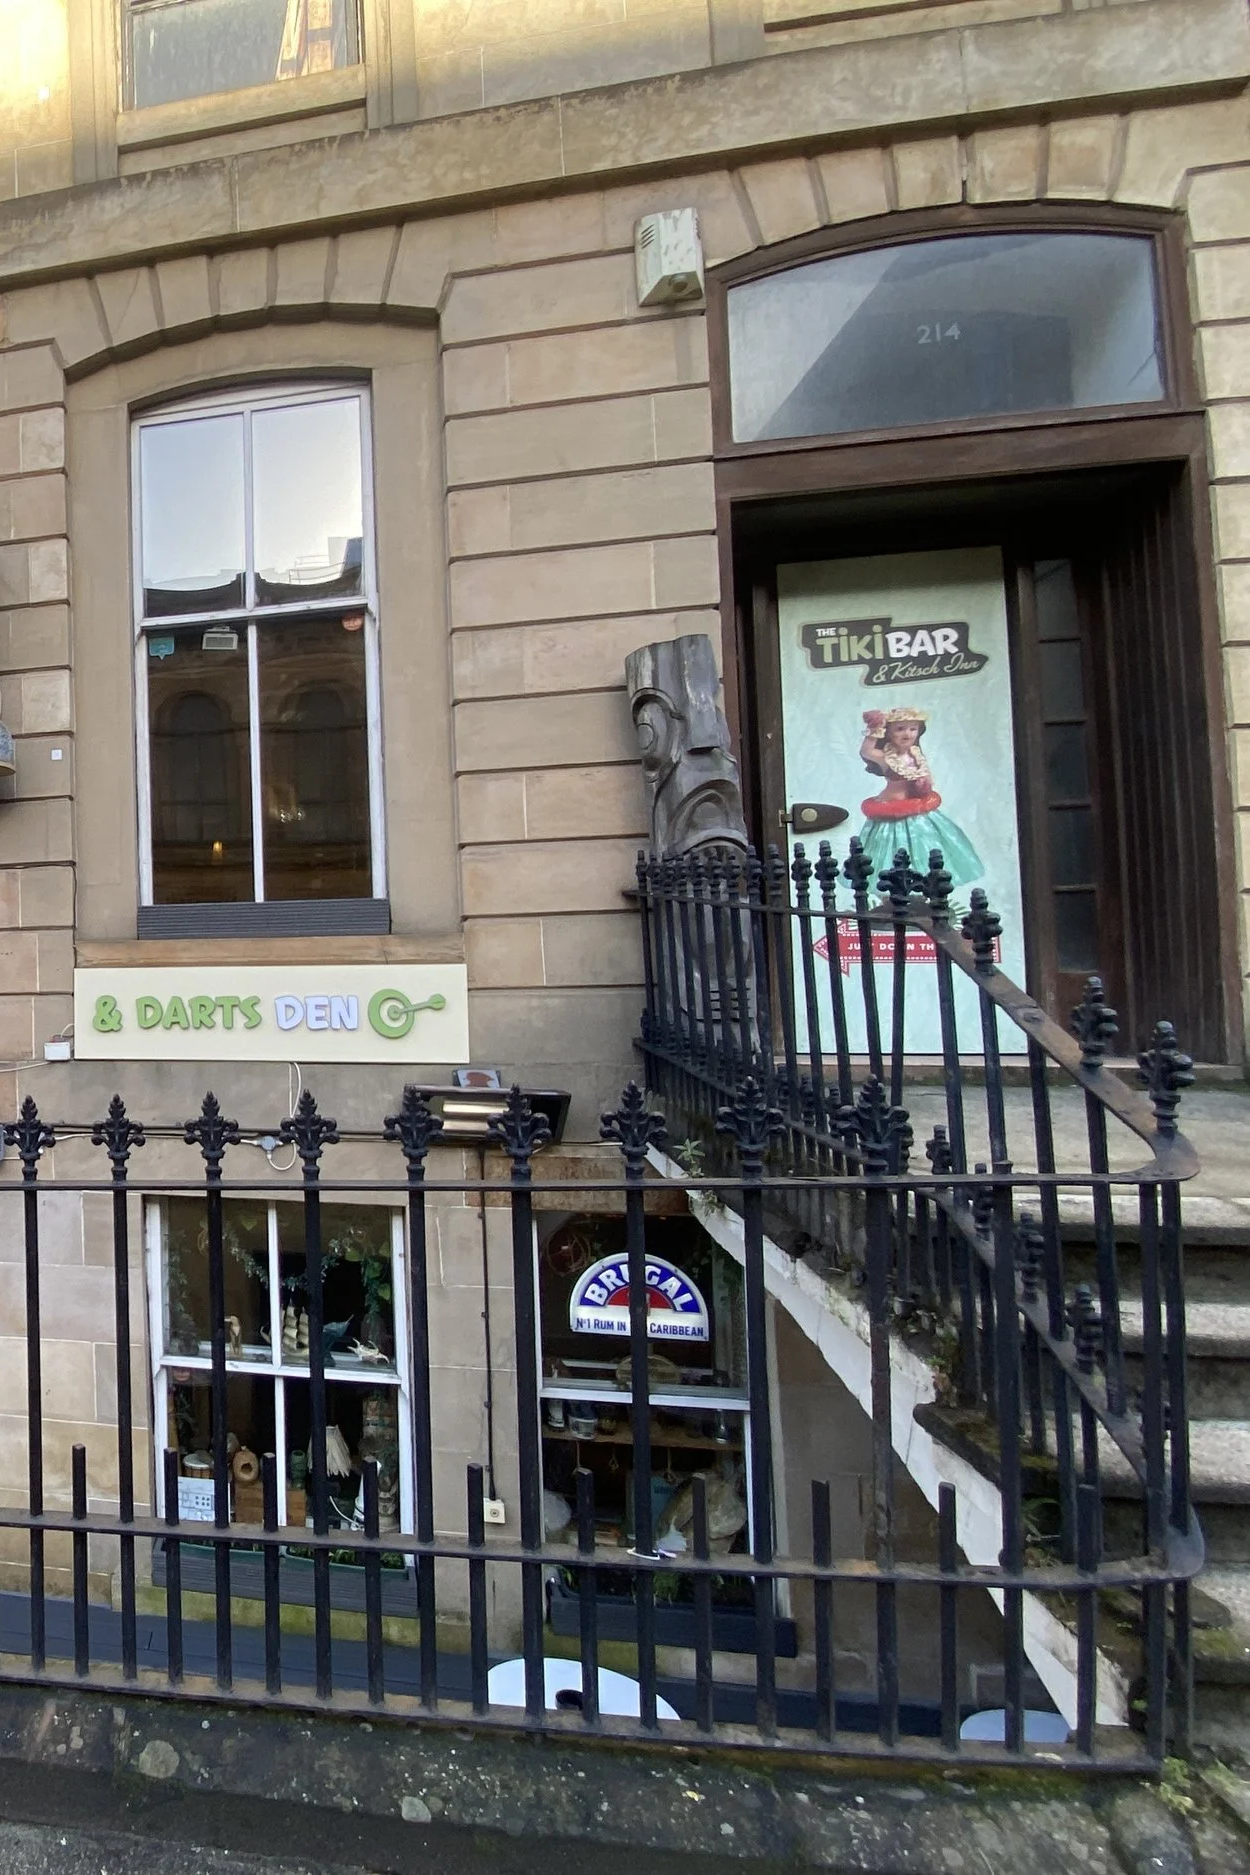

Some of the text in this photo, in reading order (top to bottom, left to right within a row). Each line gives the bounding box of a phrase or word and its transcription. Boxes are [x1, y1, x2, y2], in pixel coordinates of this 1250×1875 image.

[916, 321, 961, 344] 214
[815, 627, 836, 637] THE
[885, 627, 959, 658] BAR
[872, 652, 980, 683] & Kitsch Inn
[879, 943, 915, 951] DON
[92, 994, 359, 1033] & DARTS DEN
[593, 1318, 615, 1331] RUM
[616, 1321, 627, 1332] IN
[649, 1322, 704, 1337] CARIBBEAN
